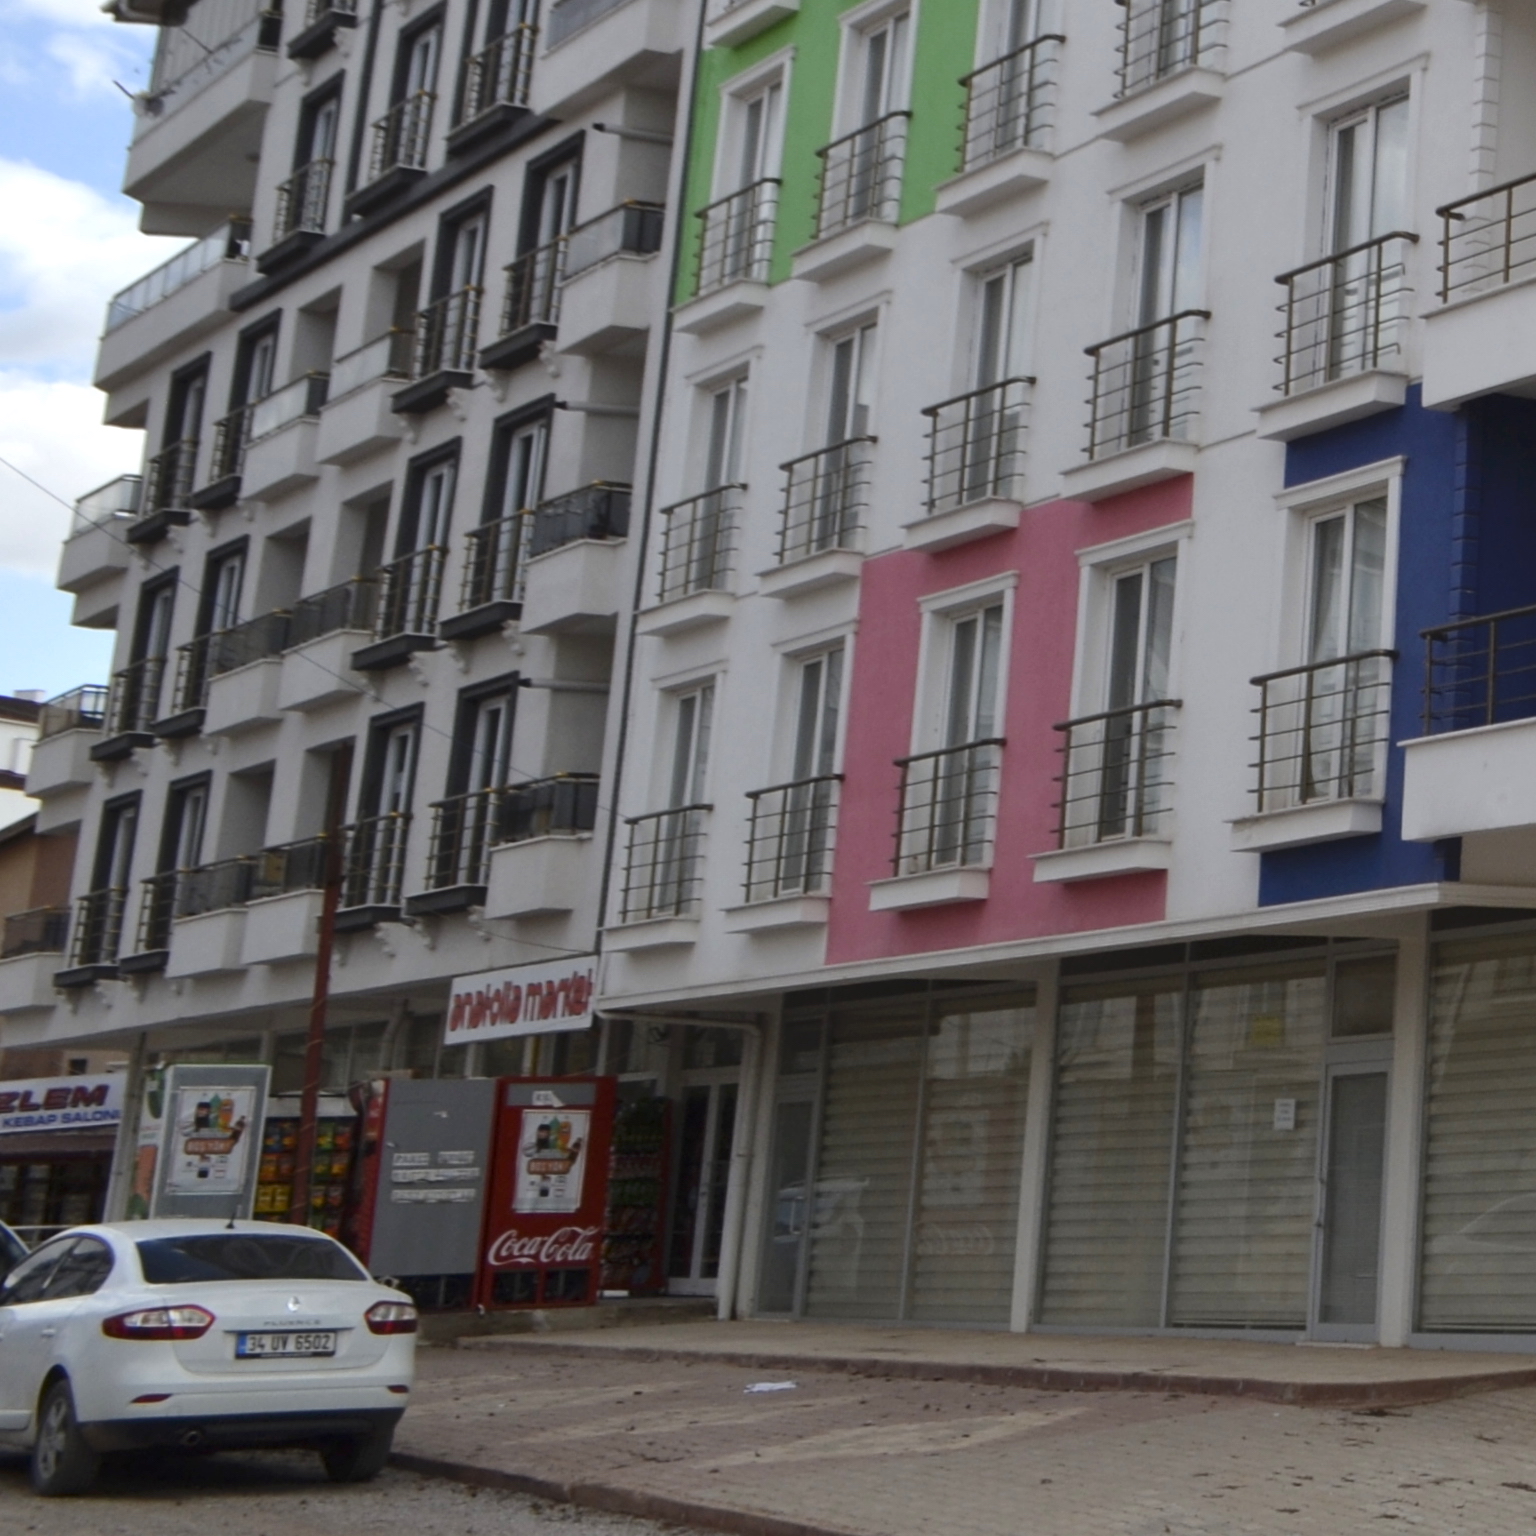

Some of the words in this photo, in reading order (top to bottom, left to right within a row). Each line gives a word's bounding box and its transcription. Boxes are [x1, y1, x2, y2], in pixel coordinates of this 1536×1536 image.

[523, 968, 592, 1022] market
[3, 1114, 57, 1127] KEBAP
[488, 1226, 599, 1265] Coca-Cola
[249, 1336, 266, 1352] 34
[271, 1335, 289, 1351] UV
[295, 1334, 331, 1350] 6502
